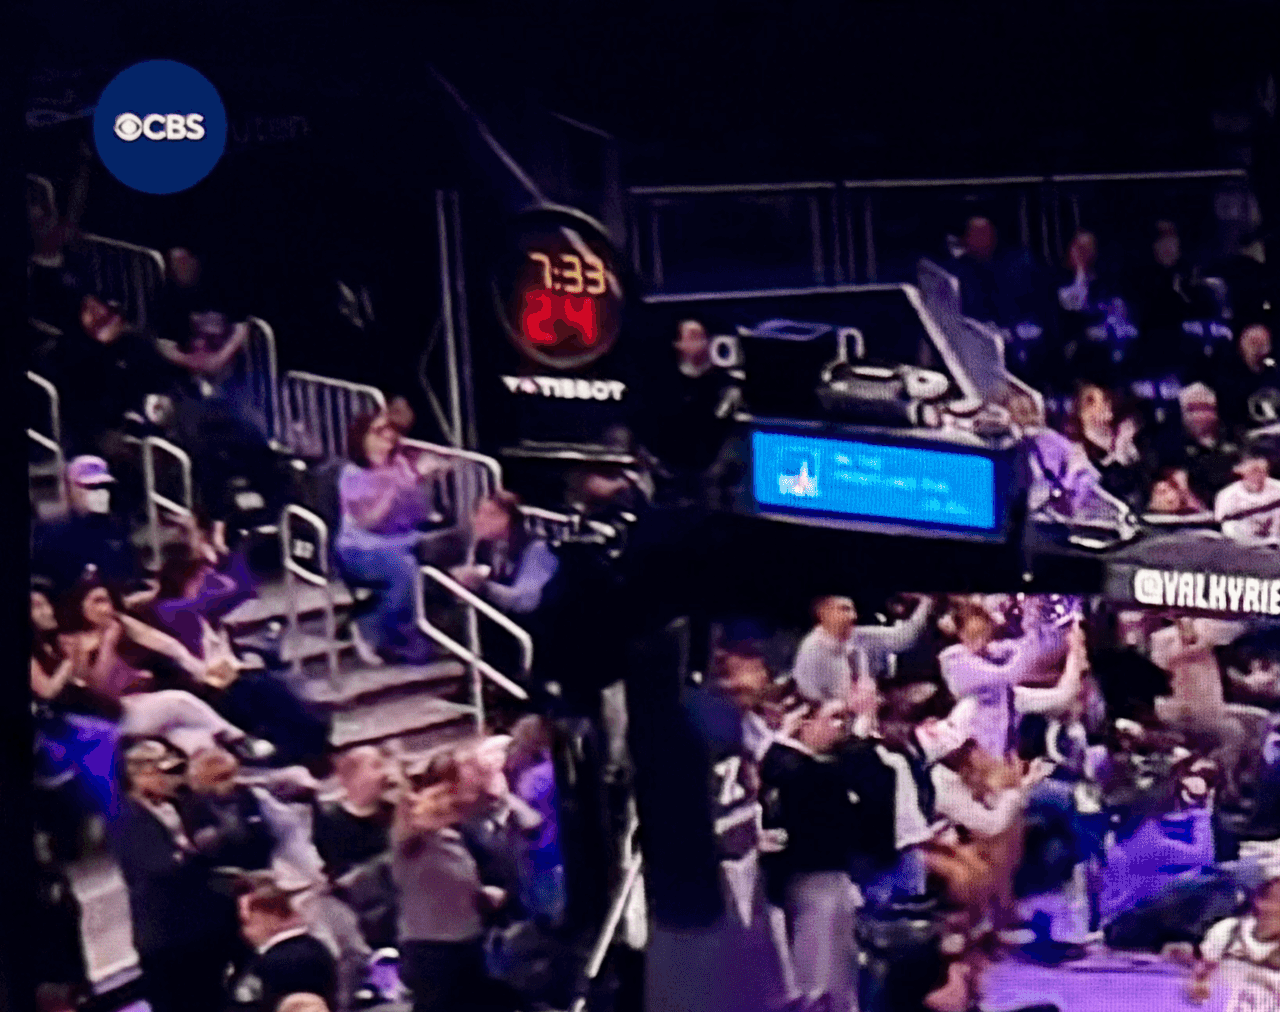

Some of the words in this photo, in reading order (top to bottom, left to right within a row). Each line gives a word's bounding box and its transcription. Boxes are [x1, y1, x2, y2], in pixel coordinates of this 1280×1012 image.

[143, 112, 206, 142] CBS
[528, 251, 607, 294] 7:33
[523, 290, 600, 345] 24
